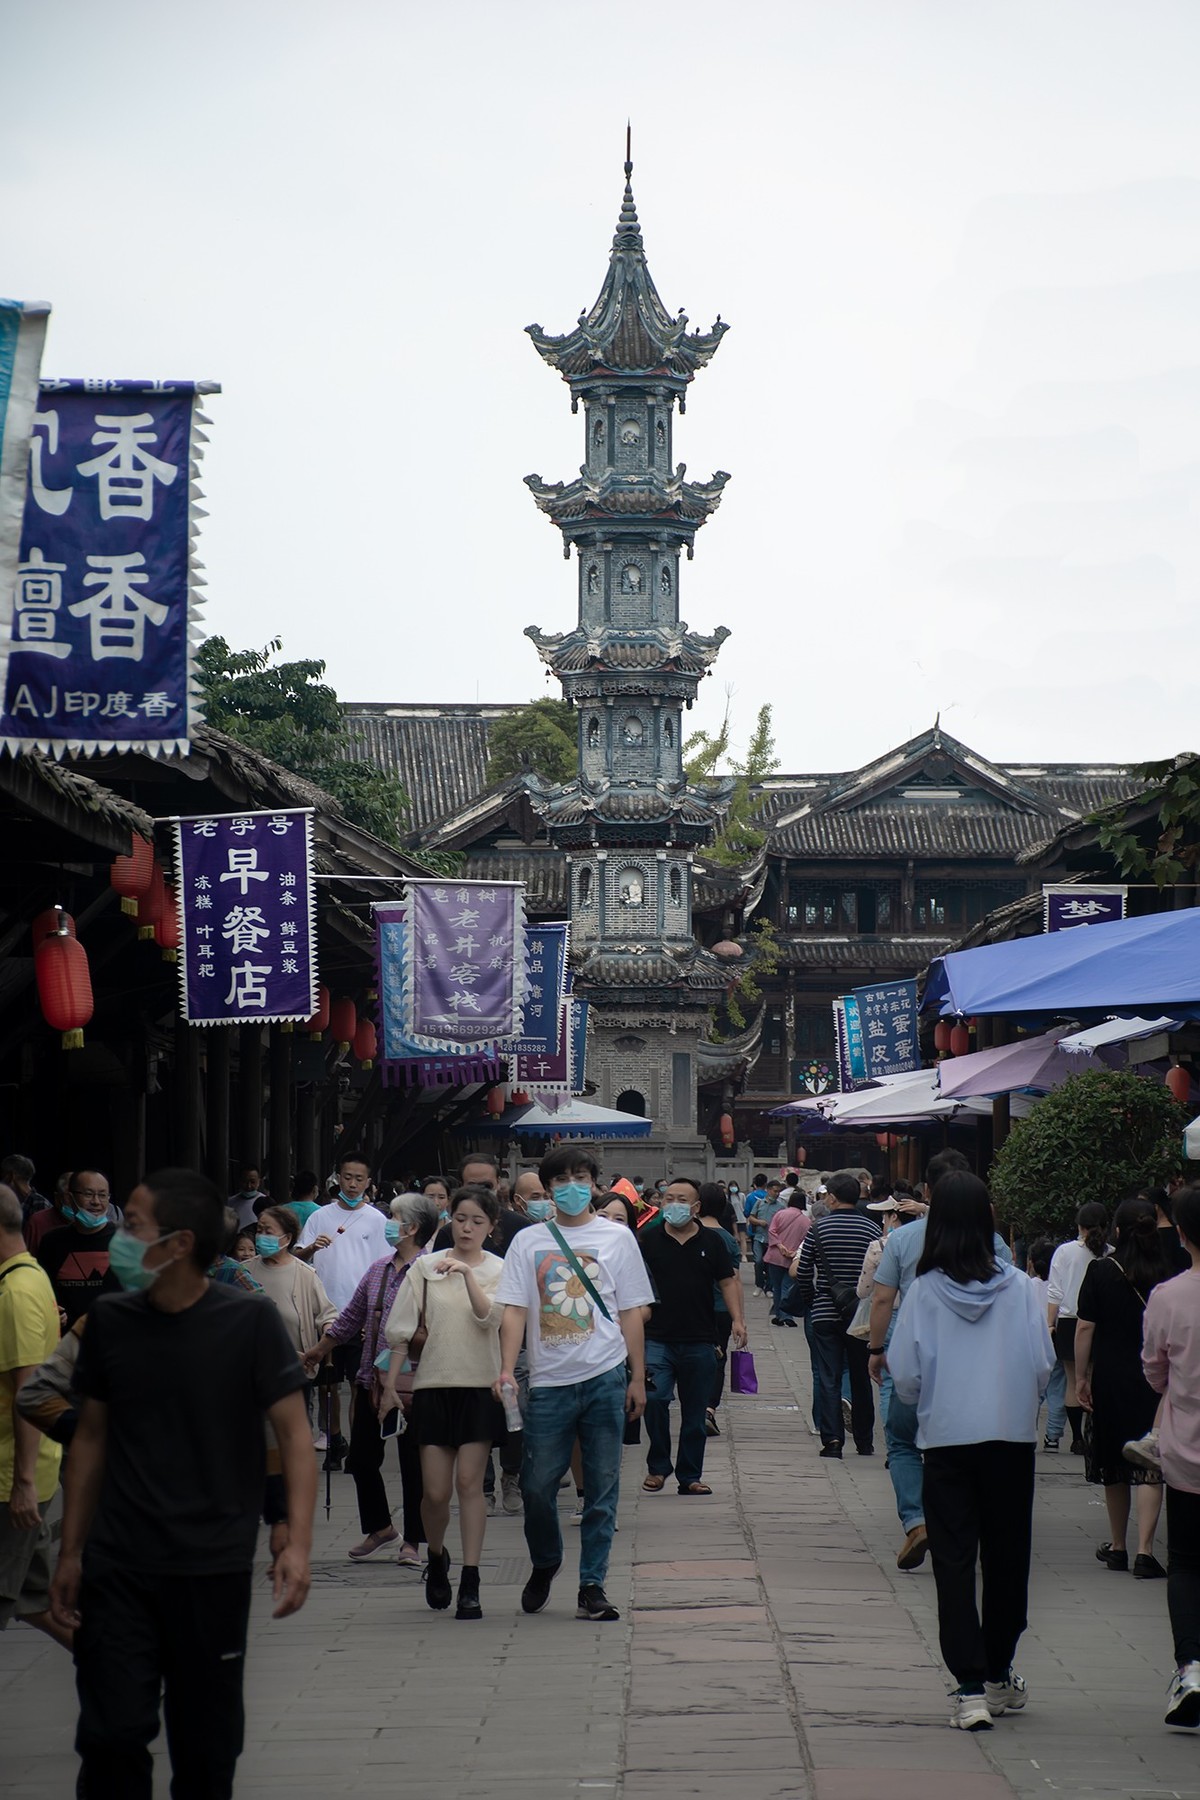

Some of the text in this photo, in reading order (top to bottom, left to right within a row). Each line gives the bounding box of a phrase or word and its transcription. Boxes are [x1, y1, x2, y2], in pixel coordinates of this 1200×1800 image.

[193, 815, 293, 837] 老字号
[194, 875, 215, 978] 冻糕 叶耳粑
[219, 848, 272, 1008] 早餐店
[279, 872, 299, 974] 油条 鲜豆浆
[431, 887, 497, 904] 皂角树
[422, 933, 440, 969] 品茗
[446, 909, 482, 1012] 老井客栈
[530, 941, 544, 973] 精品
